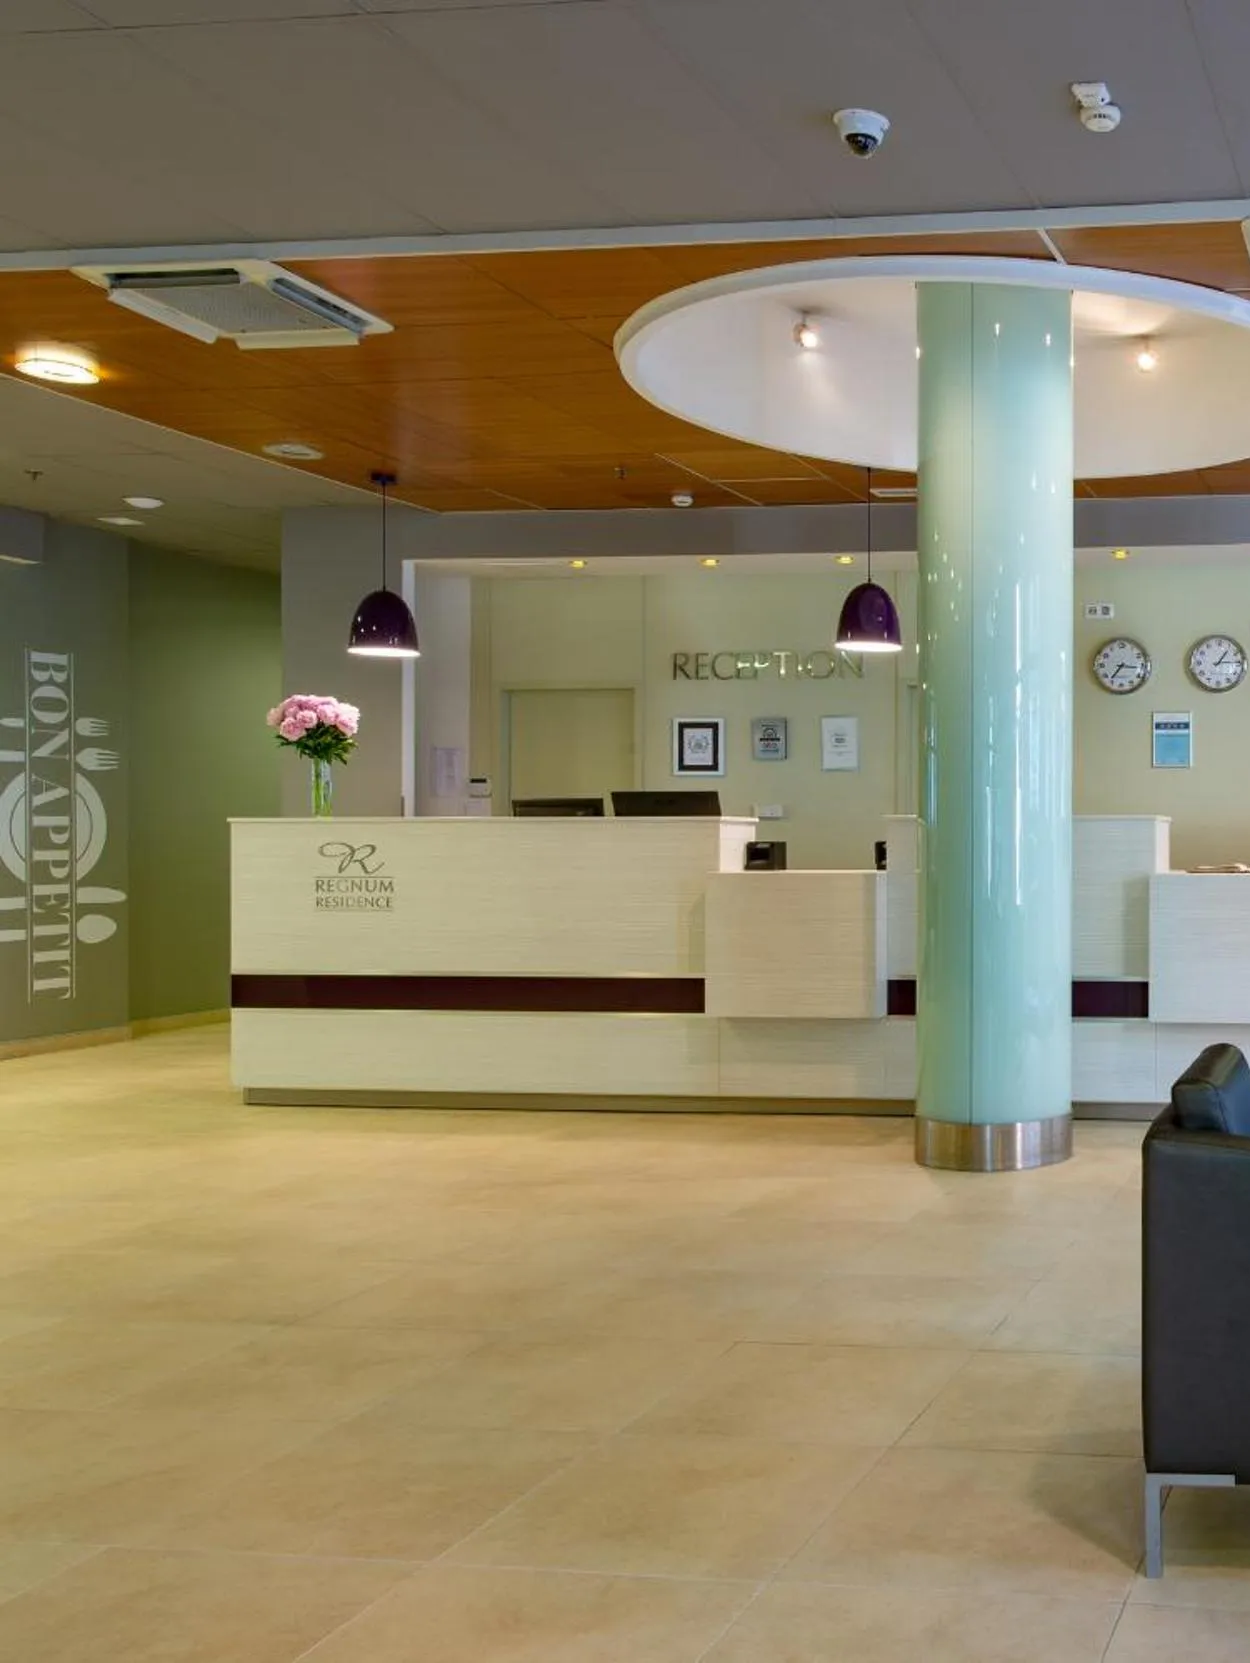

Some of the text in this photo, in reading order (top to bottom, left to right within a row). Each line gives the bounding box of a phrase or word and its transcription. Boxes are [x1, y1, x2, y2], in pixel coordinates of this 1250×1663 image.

[673, 650, 865, 681] RECEPTION
[30, 651, 72, 1000] BON APPETIT
[315, 879, 394, 893] REGNUM
[315, 896, 392, 908] RESIDENCE
